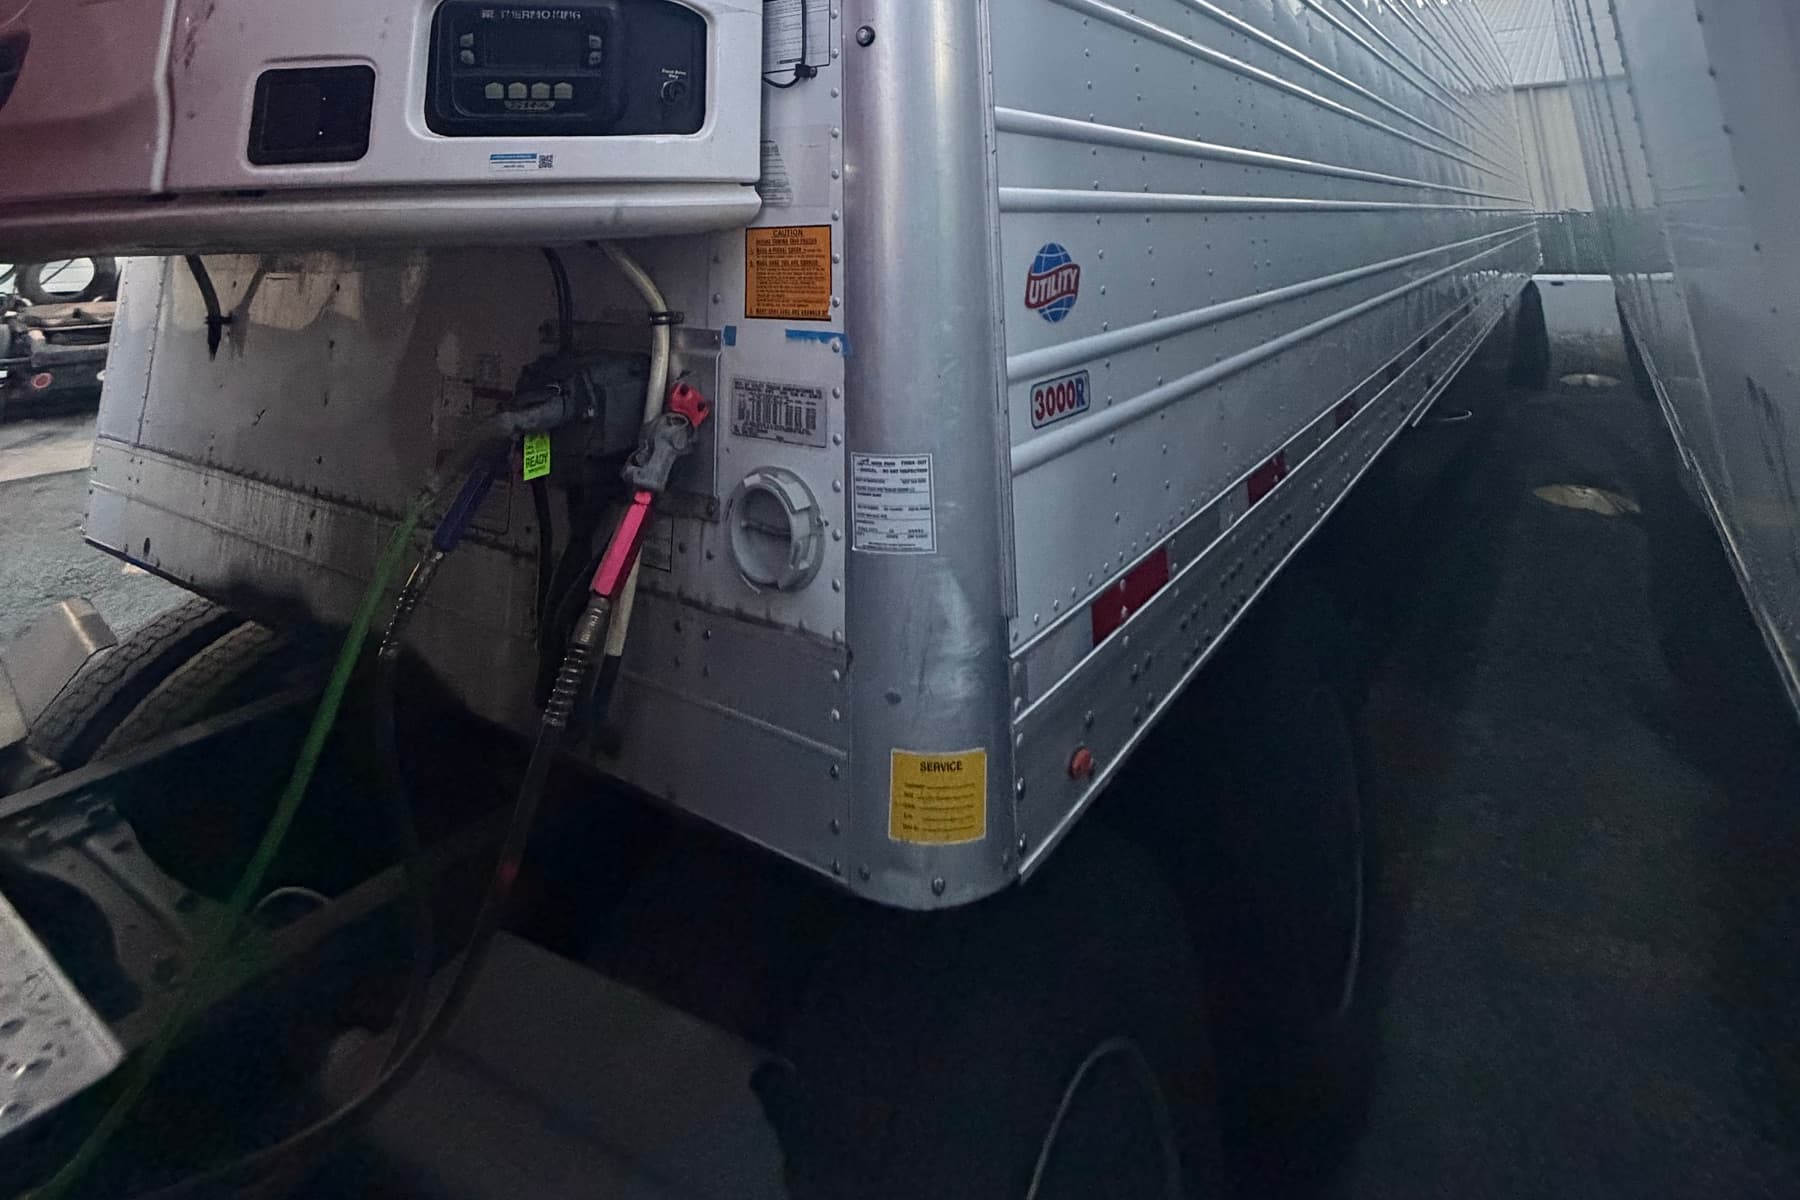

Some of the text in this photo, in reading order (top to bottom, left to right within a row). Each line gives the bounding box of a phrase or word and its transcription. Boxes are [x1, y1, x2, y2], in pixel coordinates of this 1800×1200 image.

[773, 228, 803, 238] CAUTION
[1029, 267, 1078, 305] UTILITY
[1034, 376, 1087, 422] 3000R
[919, 760, 963, 773] SERVICE
